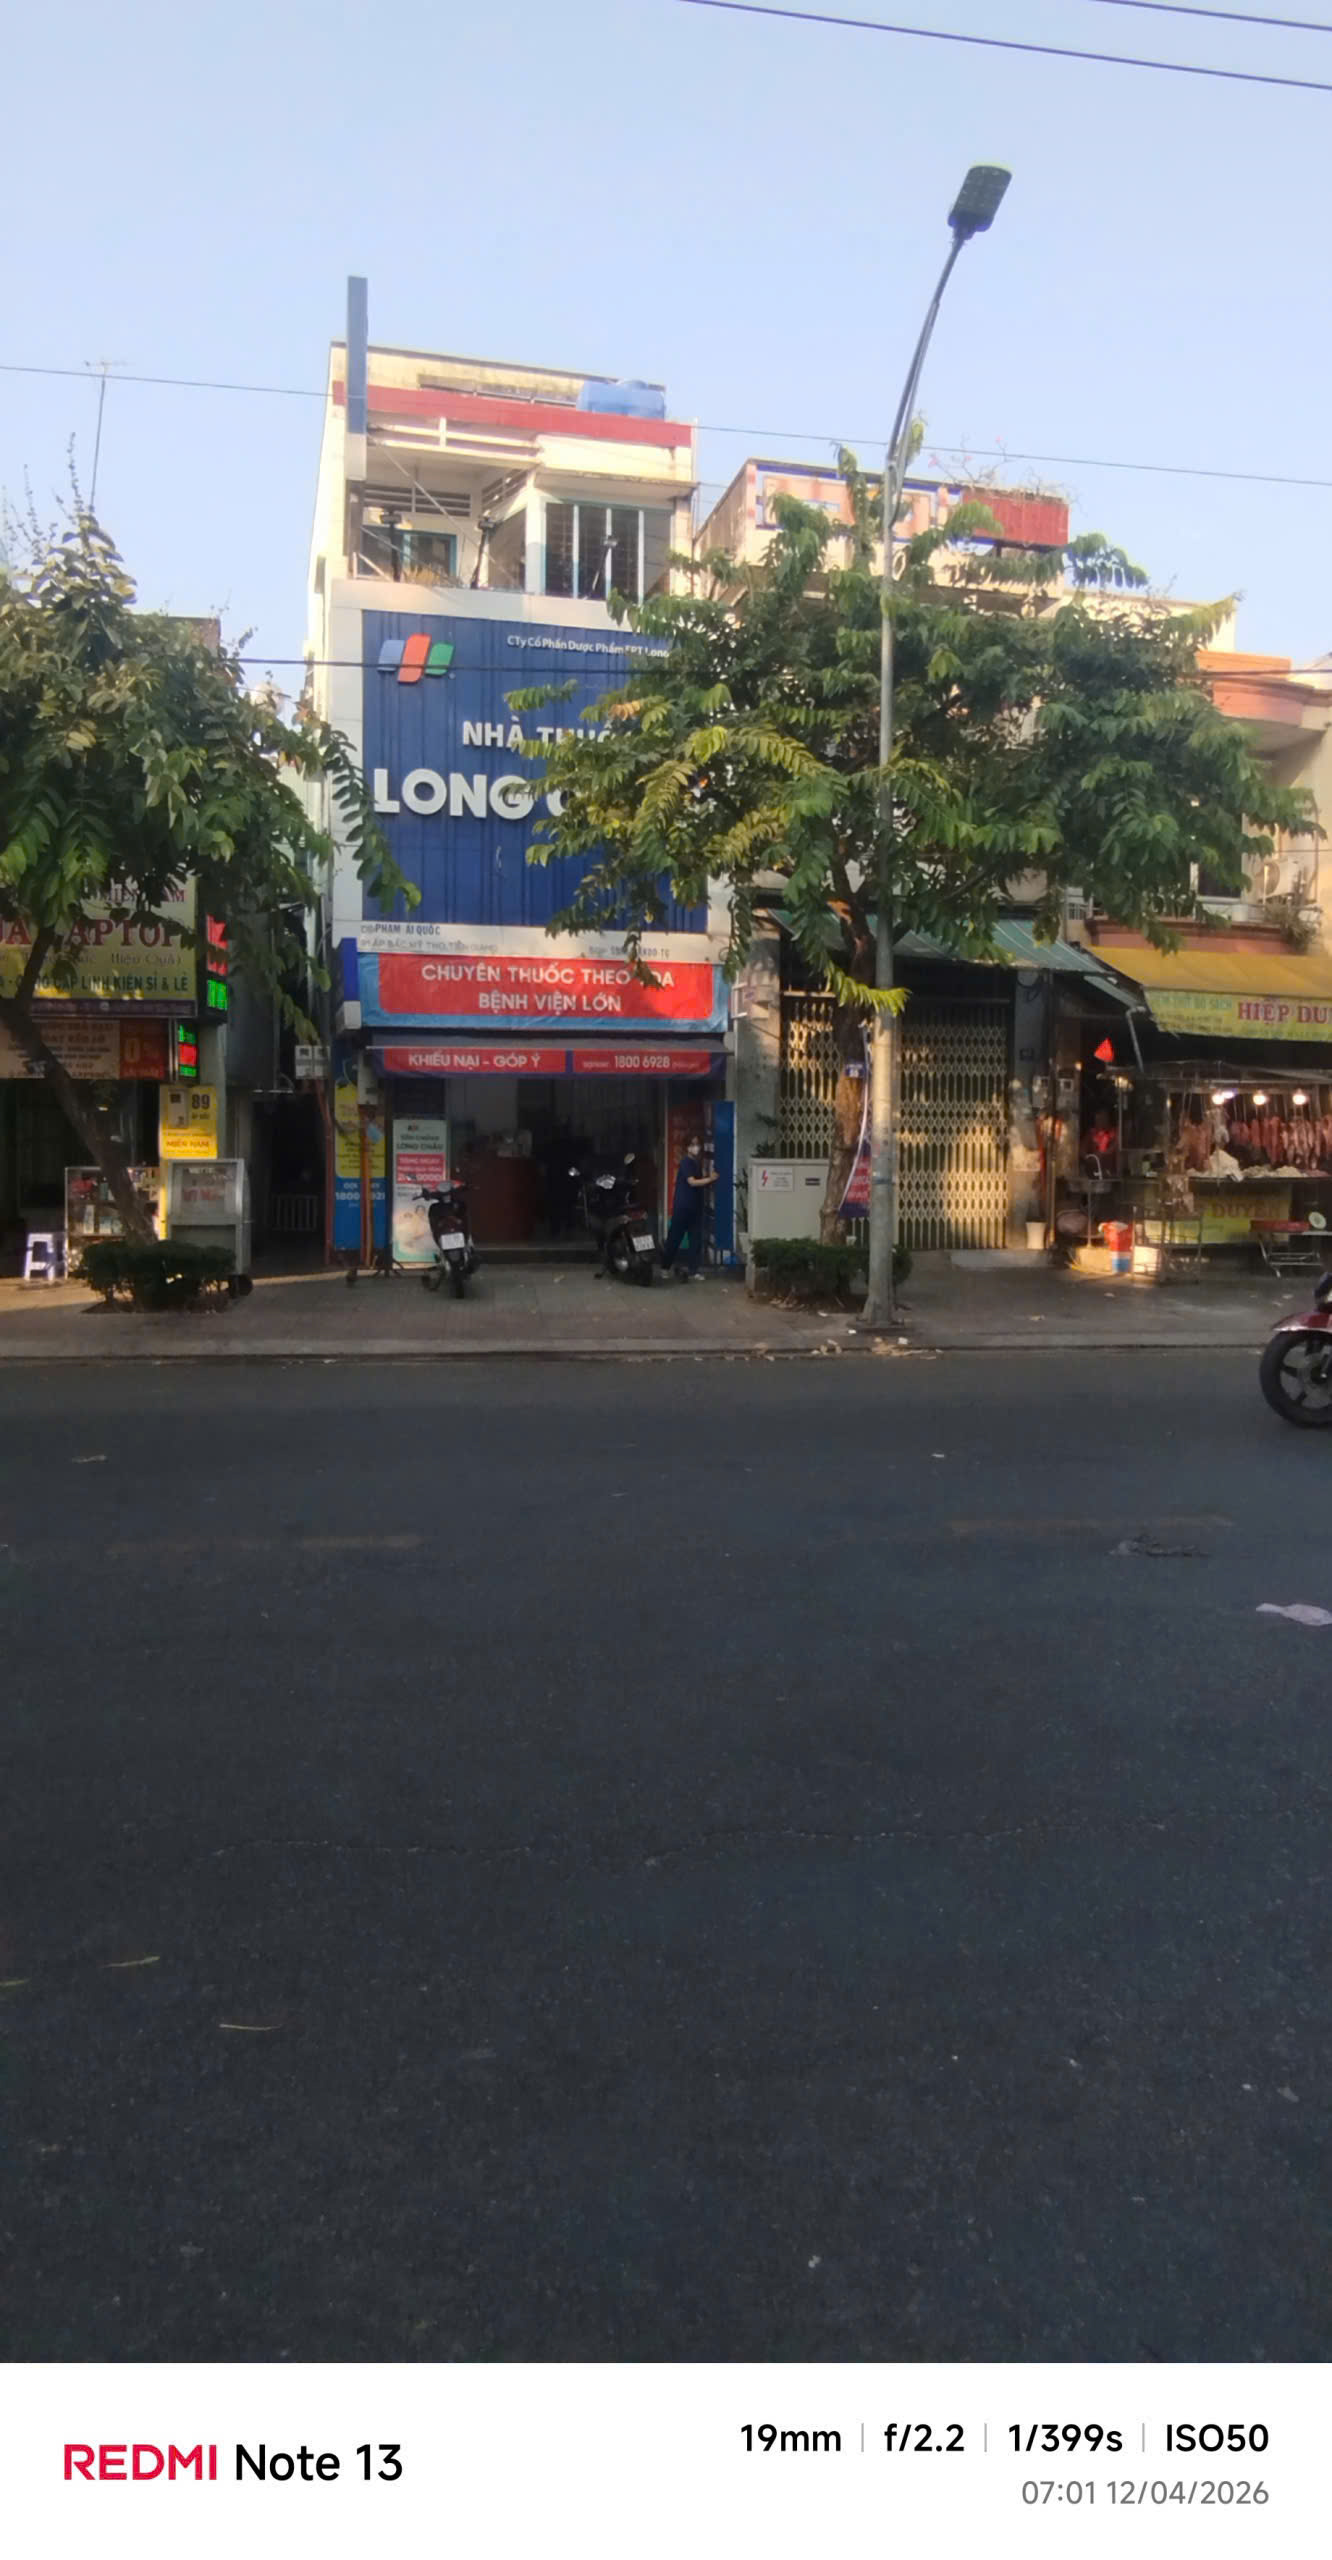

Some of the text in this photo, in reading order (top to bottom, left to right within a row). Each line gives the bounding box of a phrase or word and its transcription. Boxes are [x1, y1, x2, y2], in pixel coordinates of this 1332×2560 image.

[462, 715, 525, 749] NHÀ
[374, 767, 536, 821] LONG
[421, 961, 500, 983] CHUYÊN
[507, 961, 575, 985] THUỐC
[581, 968, 632, 986] THEO
[478, 989, 622, 1016] BỆNH VIỆN LỚN
[1238, 994, 1290, 1027] HIỆP
[1297, 1005, 1332, 1024] DU
[408, 1051, 450, 1067] KHIẾU
[453, 1055, 480, 1070] NẠI
[493, 1053, 527, 1068] GÓP
[531, 1054, 541, 1068] Ý
[614, 1056, 641, 1068] 1800
[643, 1056, 671, 1069] 6928
[191, 1093, 211, 1111] 89
